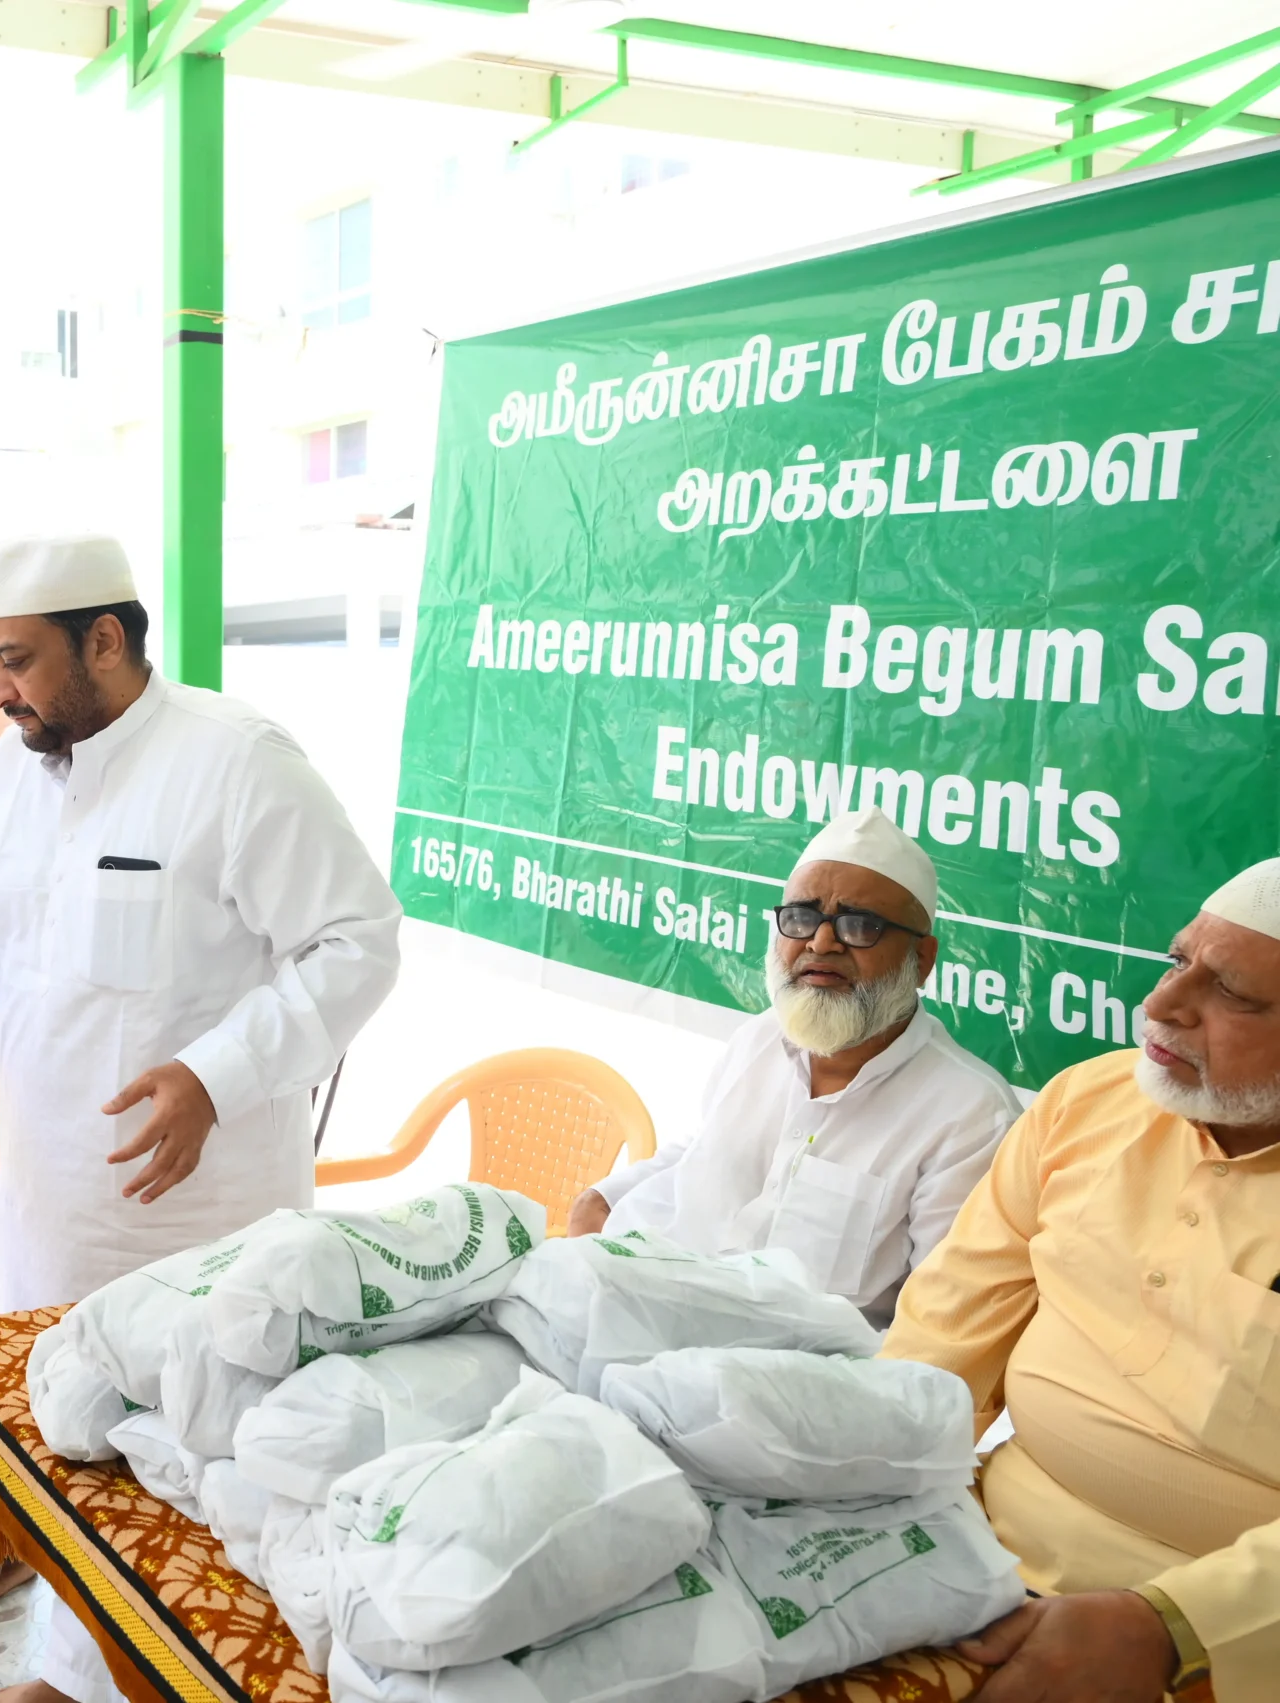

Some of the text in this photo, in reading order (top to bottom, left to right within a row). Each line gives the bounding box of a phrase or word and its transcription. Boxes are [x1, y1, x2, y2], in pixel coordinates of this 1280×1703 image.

[488, 333, 866, 448] அமீருன்னிசா
[882, 264, 1148, 387] பேகம்
[657, 426, 1199, 542] அறக்கட்டளை
[467, 603, 1280, 717] Ameerunnisa Begum Sa
[652, 725, 1122, 869] Endowments
[411, 835, 501, 901] 165/76,
[511, 855, 644, 929] Bharathi
[652, 886, 748, 954] Salai
[404, 1260, 454, 1282] SAHIBA'S
[452, 1233, 482, 1274] BEGUM
